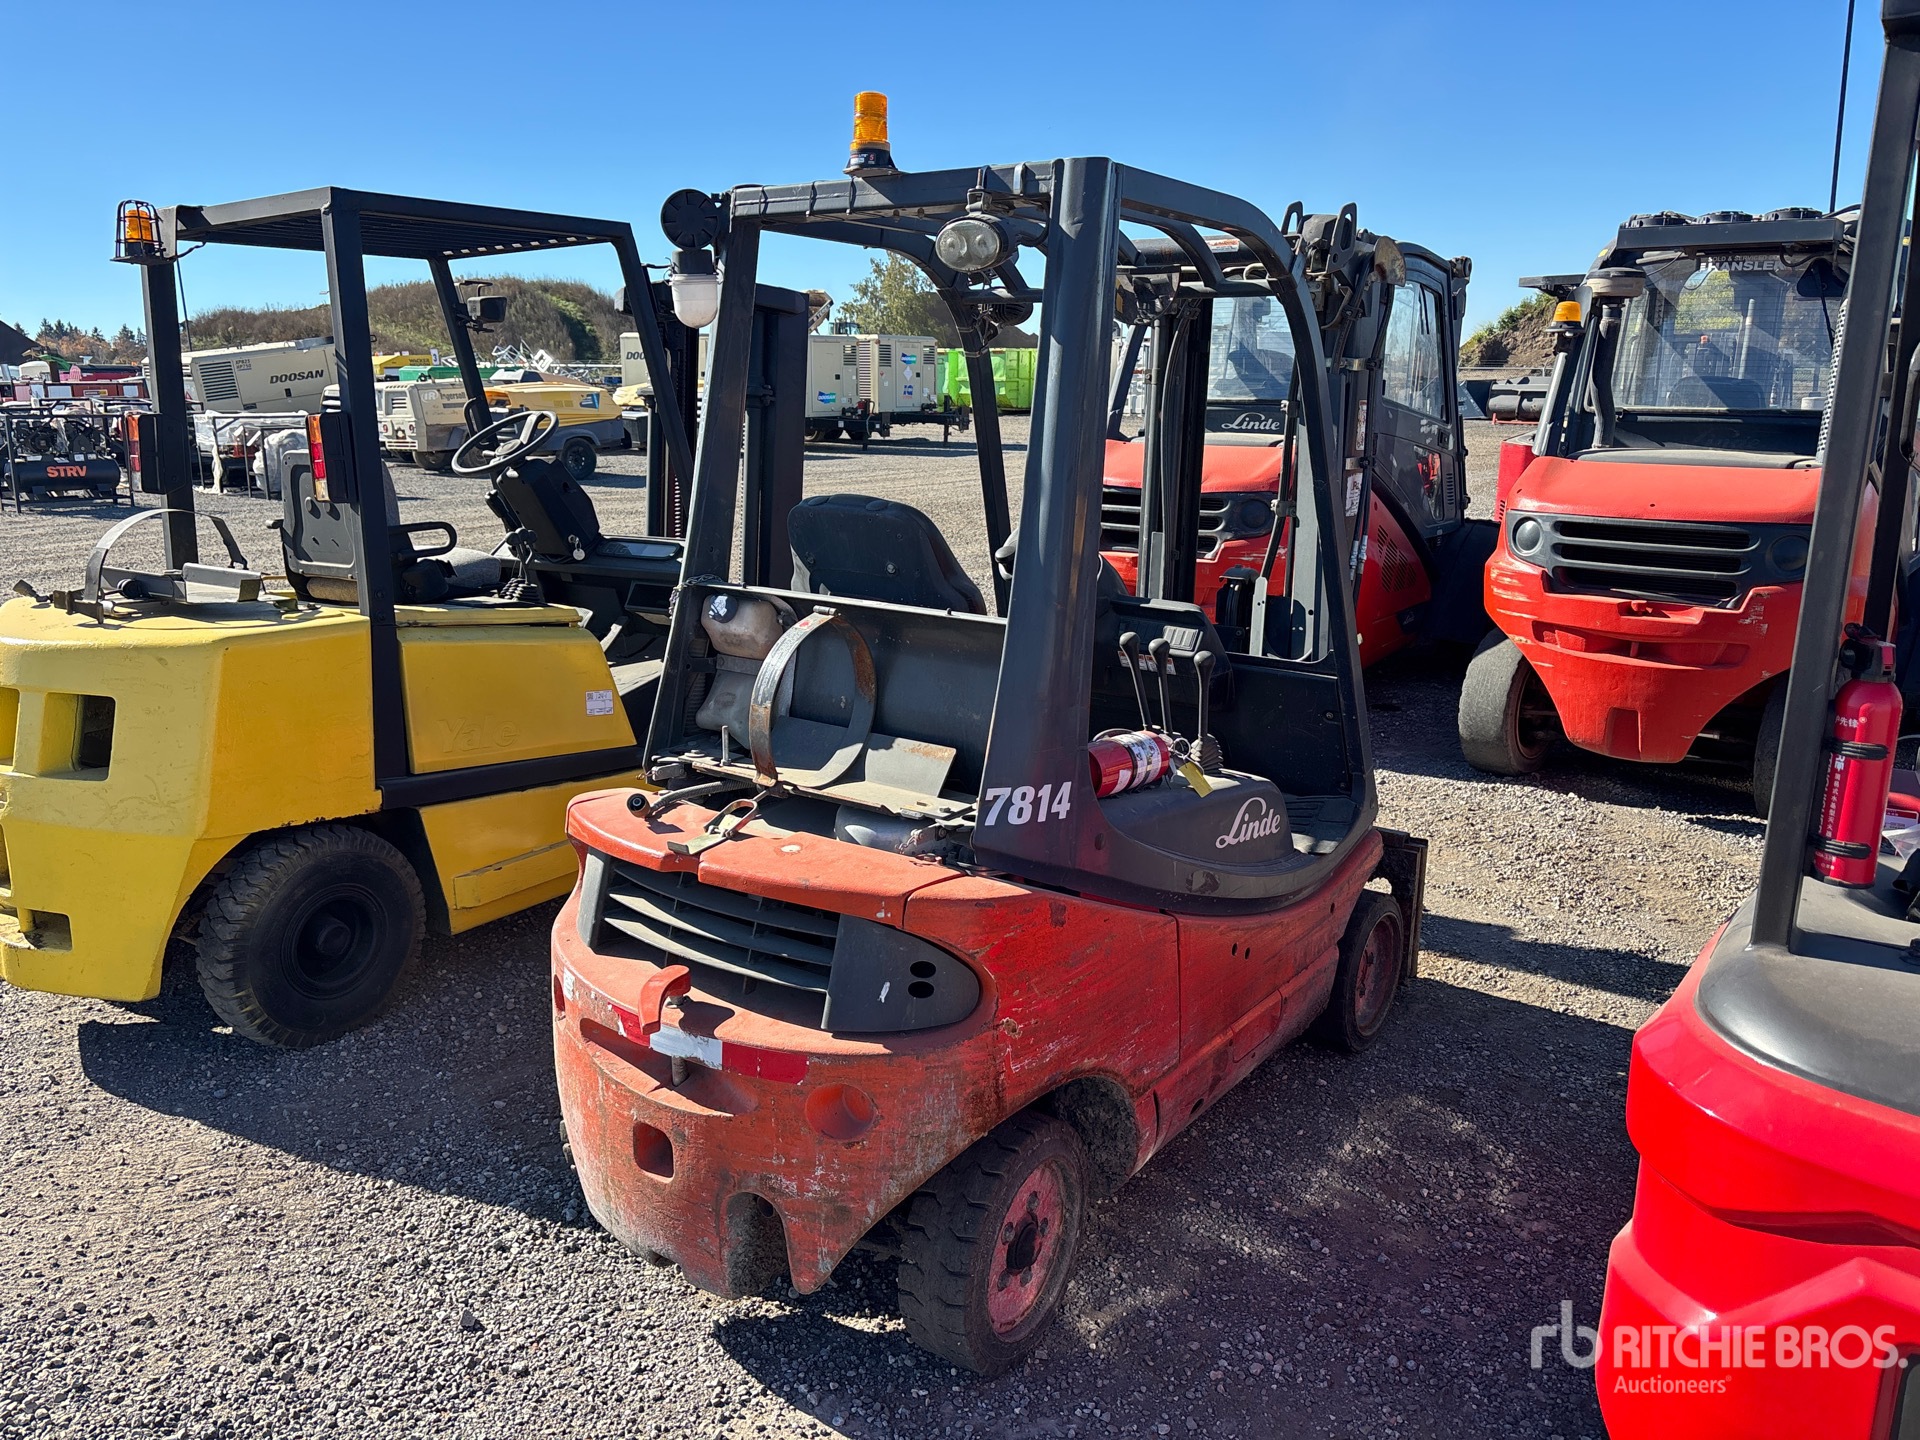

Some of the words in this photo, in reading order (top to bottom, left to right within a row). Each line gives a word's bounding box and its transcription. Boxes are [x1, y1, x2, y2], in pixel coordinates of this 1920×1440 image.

[432, 353, 438, 362] 3
[626, 351, 645, 360] DOO
[269, 369, 324, 384] DOOSAN
[1221, 412, 1280, 430] Linde
[46, 465, 87, 478] STRV
[437, 714, 520, 754] Yale
[984, 780, 1073, 827] 7814
[1215, 796, 1281, 849] Linde
